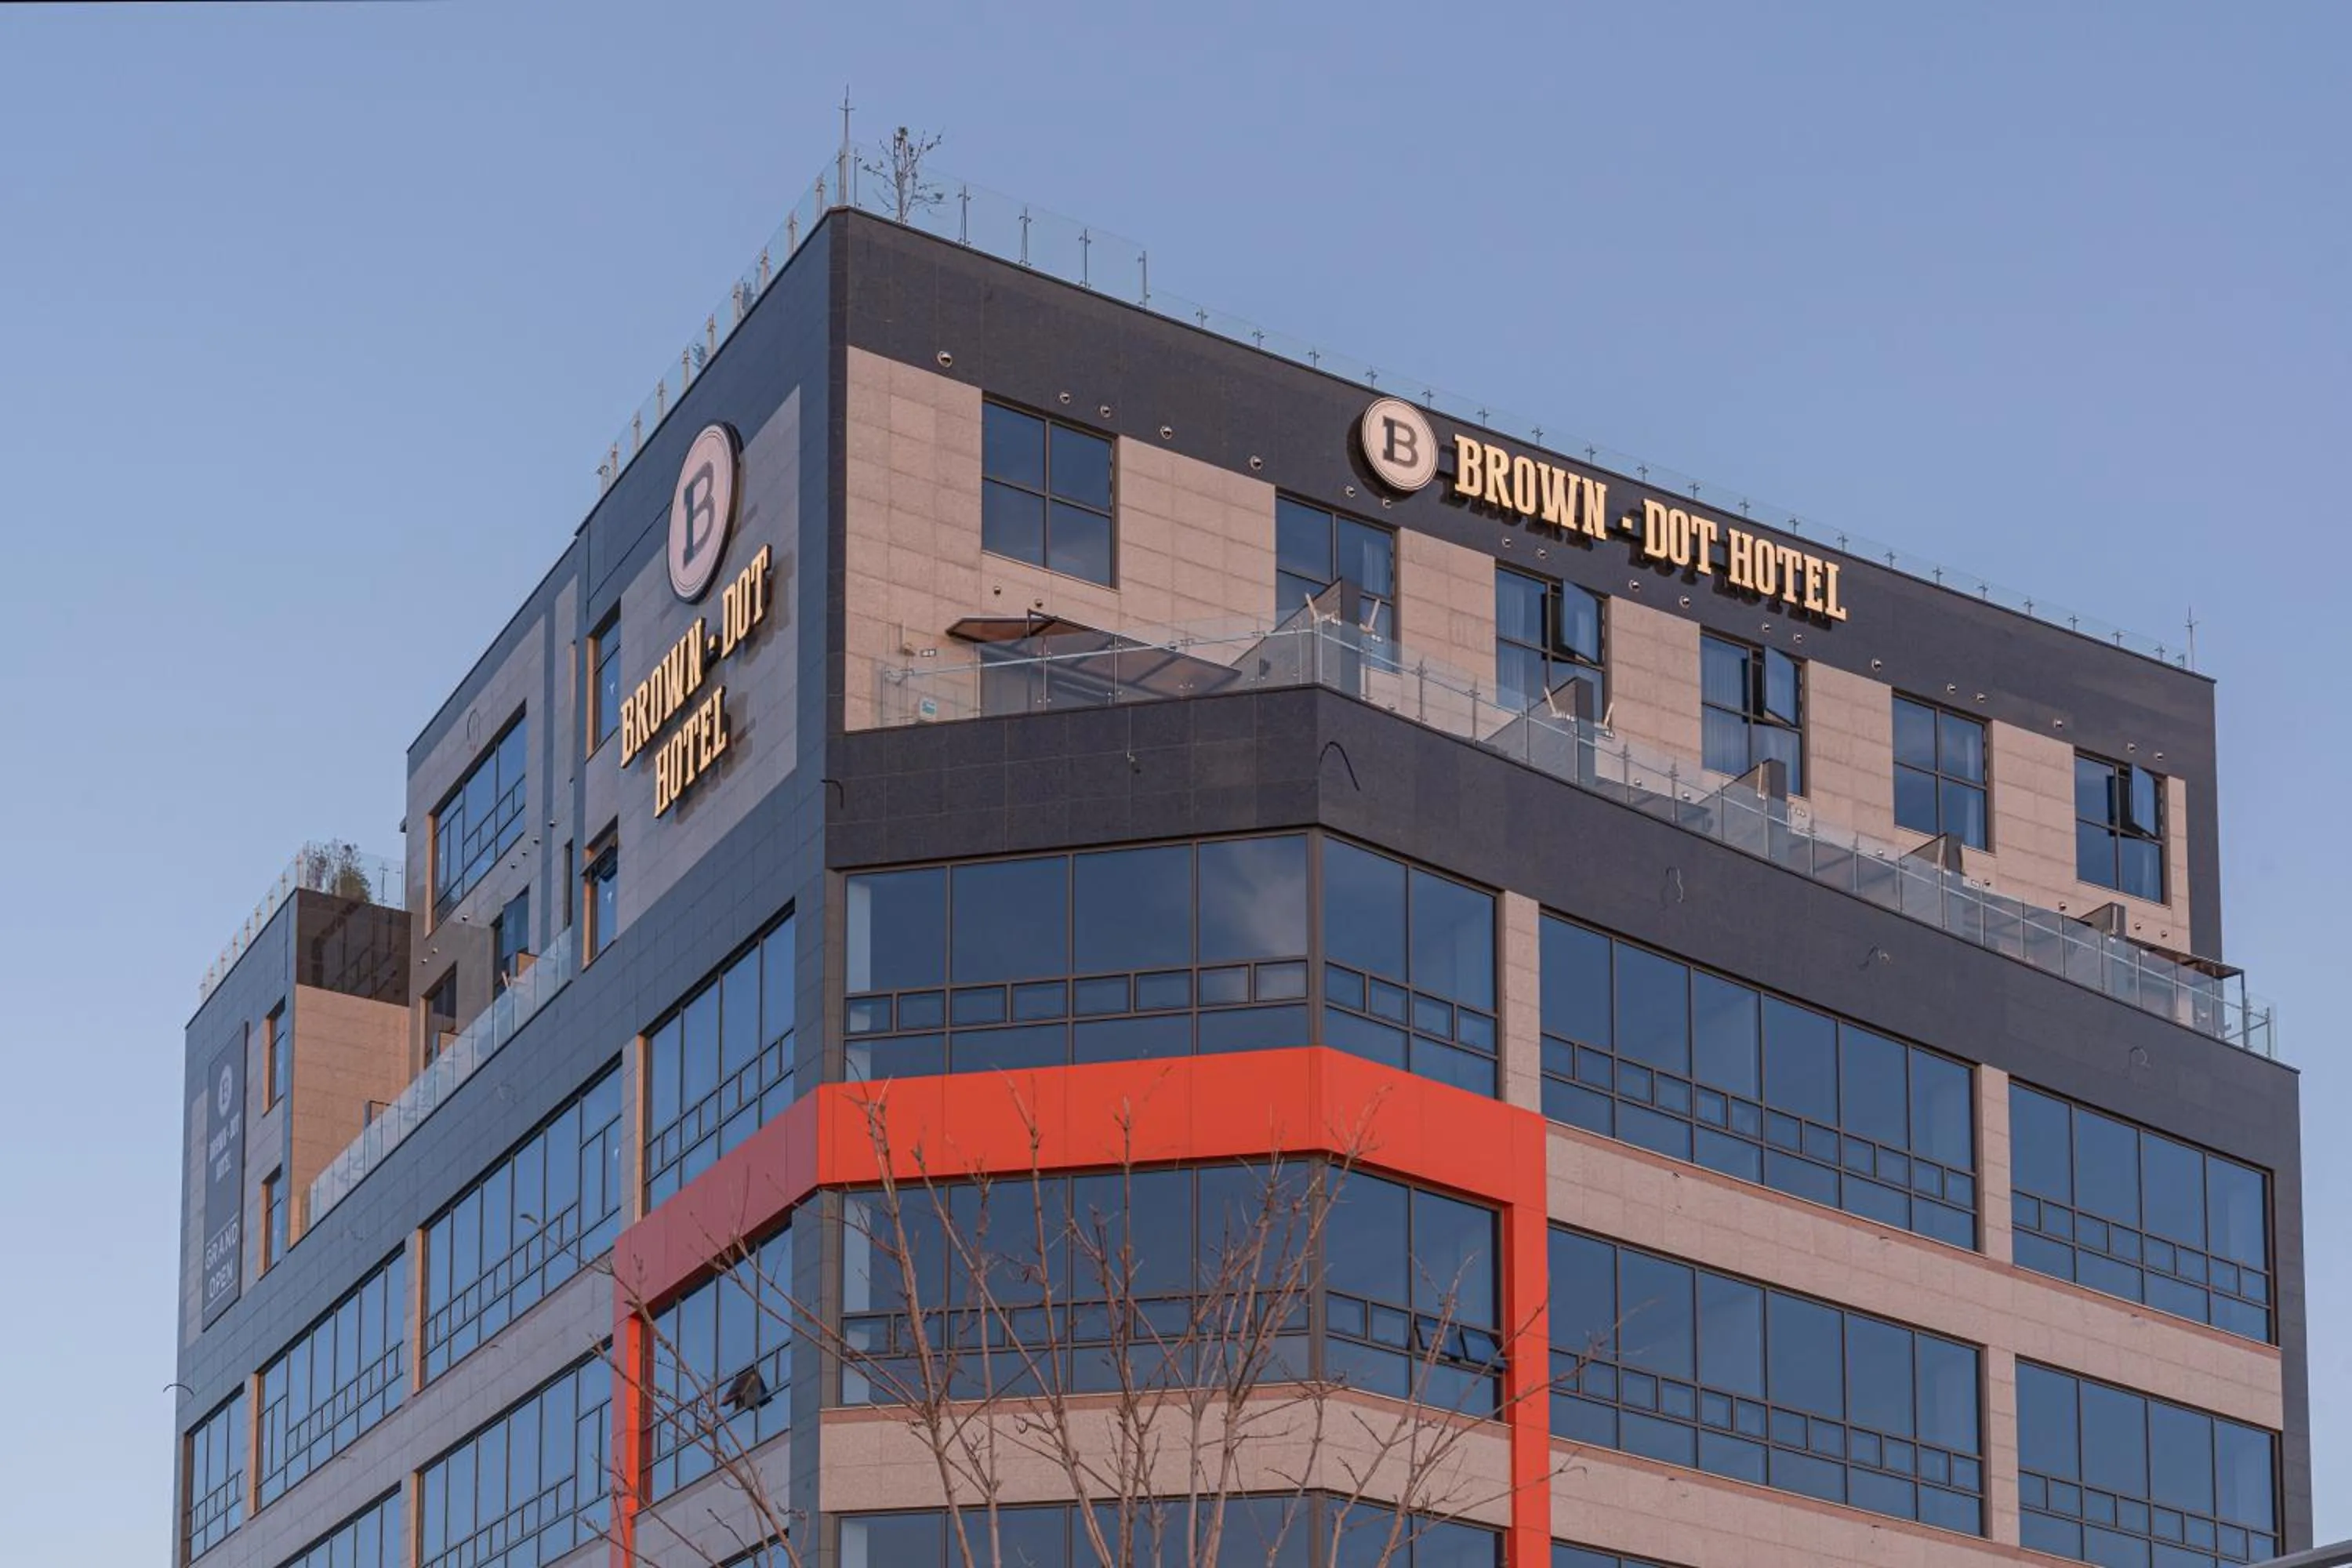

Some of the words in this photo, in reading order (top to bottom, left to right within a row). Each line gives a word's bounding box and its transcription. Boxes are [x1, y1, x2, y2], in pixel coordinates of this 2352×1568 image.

[1382, 417, 1419, 469] B
[683, 462, 717, 570] B
[1454, 434, 1607, 541] BROWN
[1642, 499, 1719, 575] DOT
[1728, 527, 1847, 621] HOTEL
[620, 616, 706, 768] BROWN
[720, 545, 771, 659] DOT
[654, 687, 728, 818] HOTEL
[205, 1221, 238, 1270] GRAND
[209, 1258, 234, 1298] OPEN
